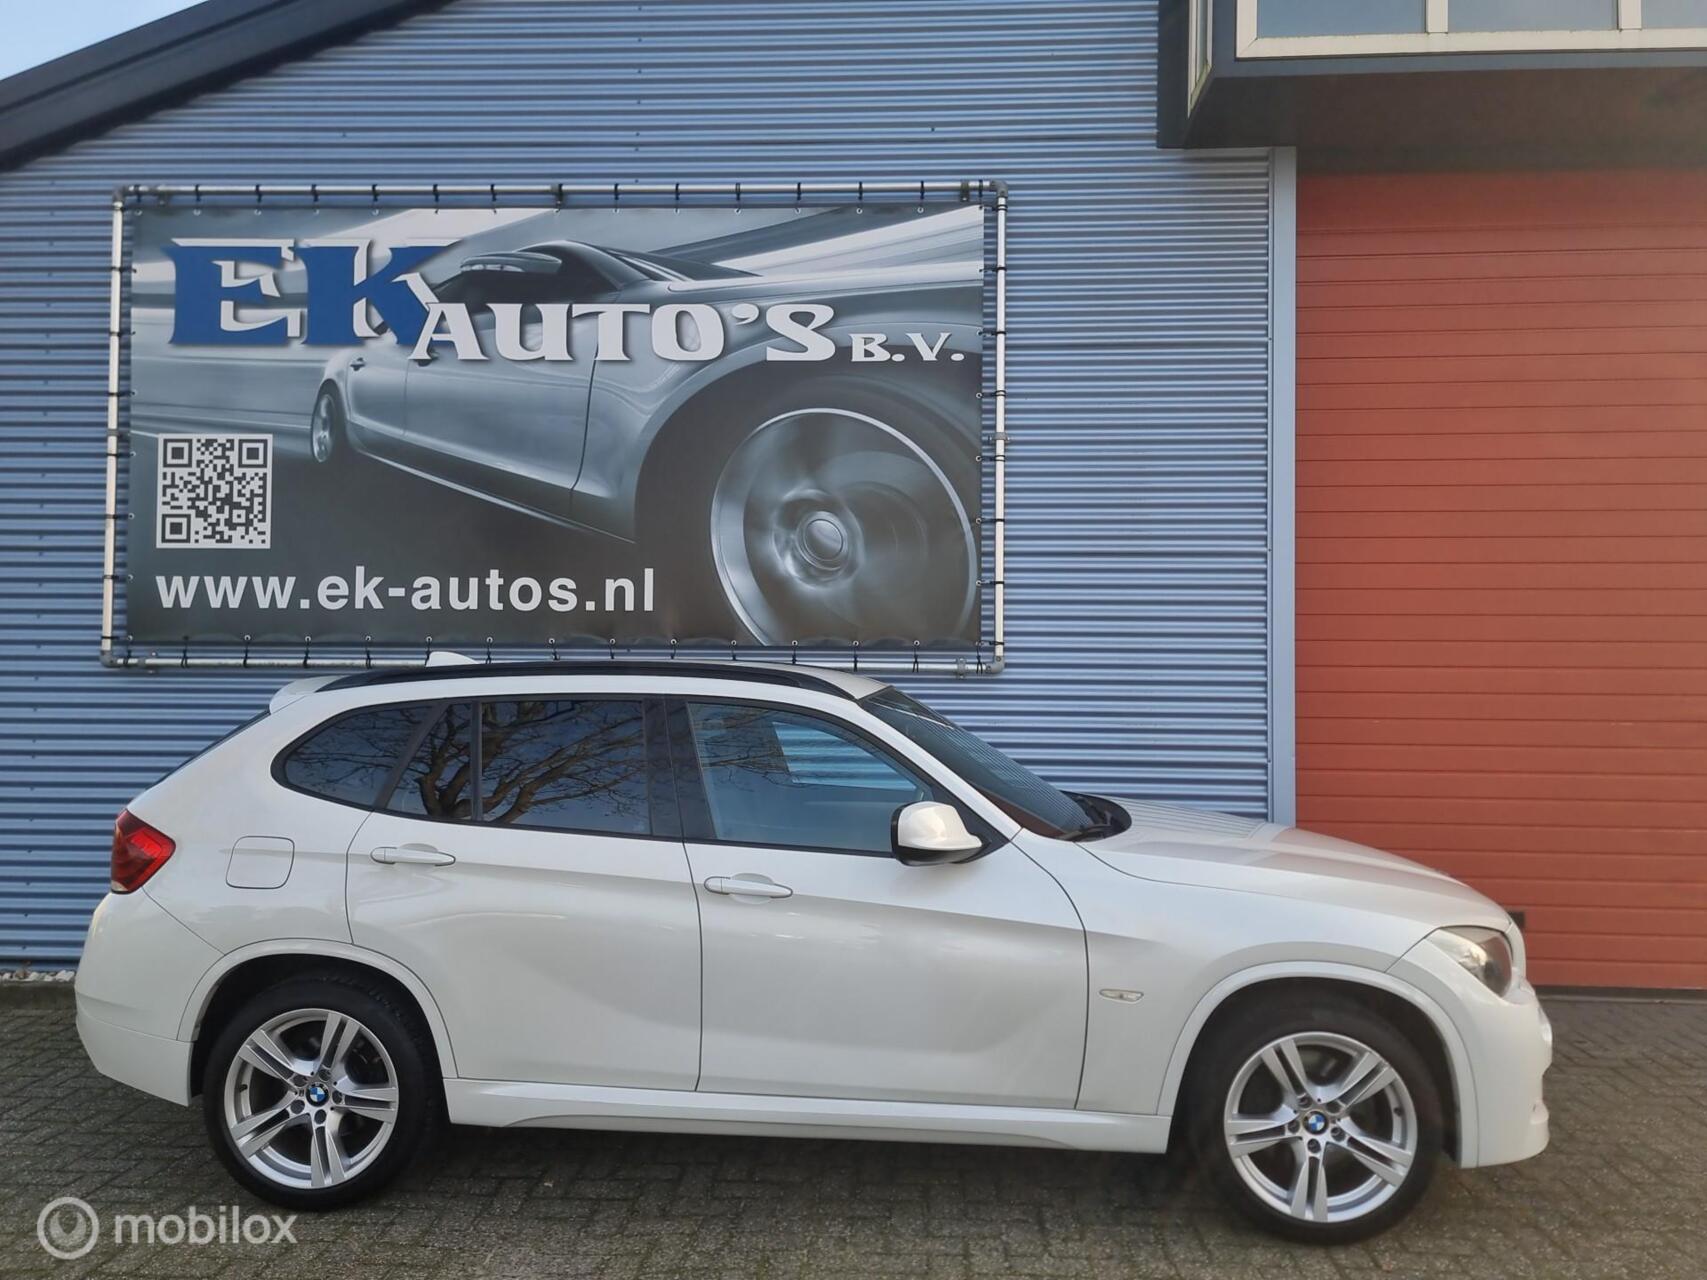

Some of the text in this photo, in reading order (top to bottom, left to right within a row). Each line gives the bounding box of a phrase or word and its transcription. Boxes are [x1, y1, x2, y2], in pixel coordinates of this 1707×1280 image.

[163, 237, 466, 348] EK
[850, 331, 965, 362] B.V.
[156, 566, 655, 612] www.ek-autos.nl
